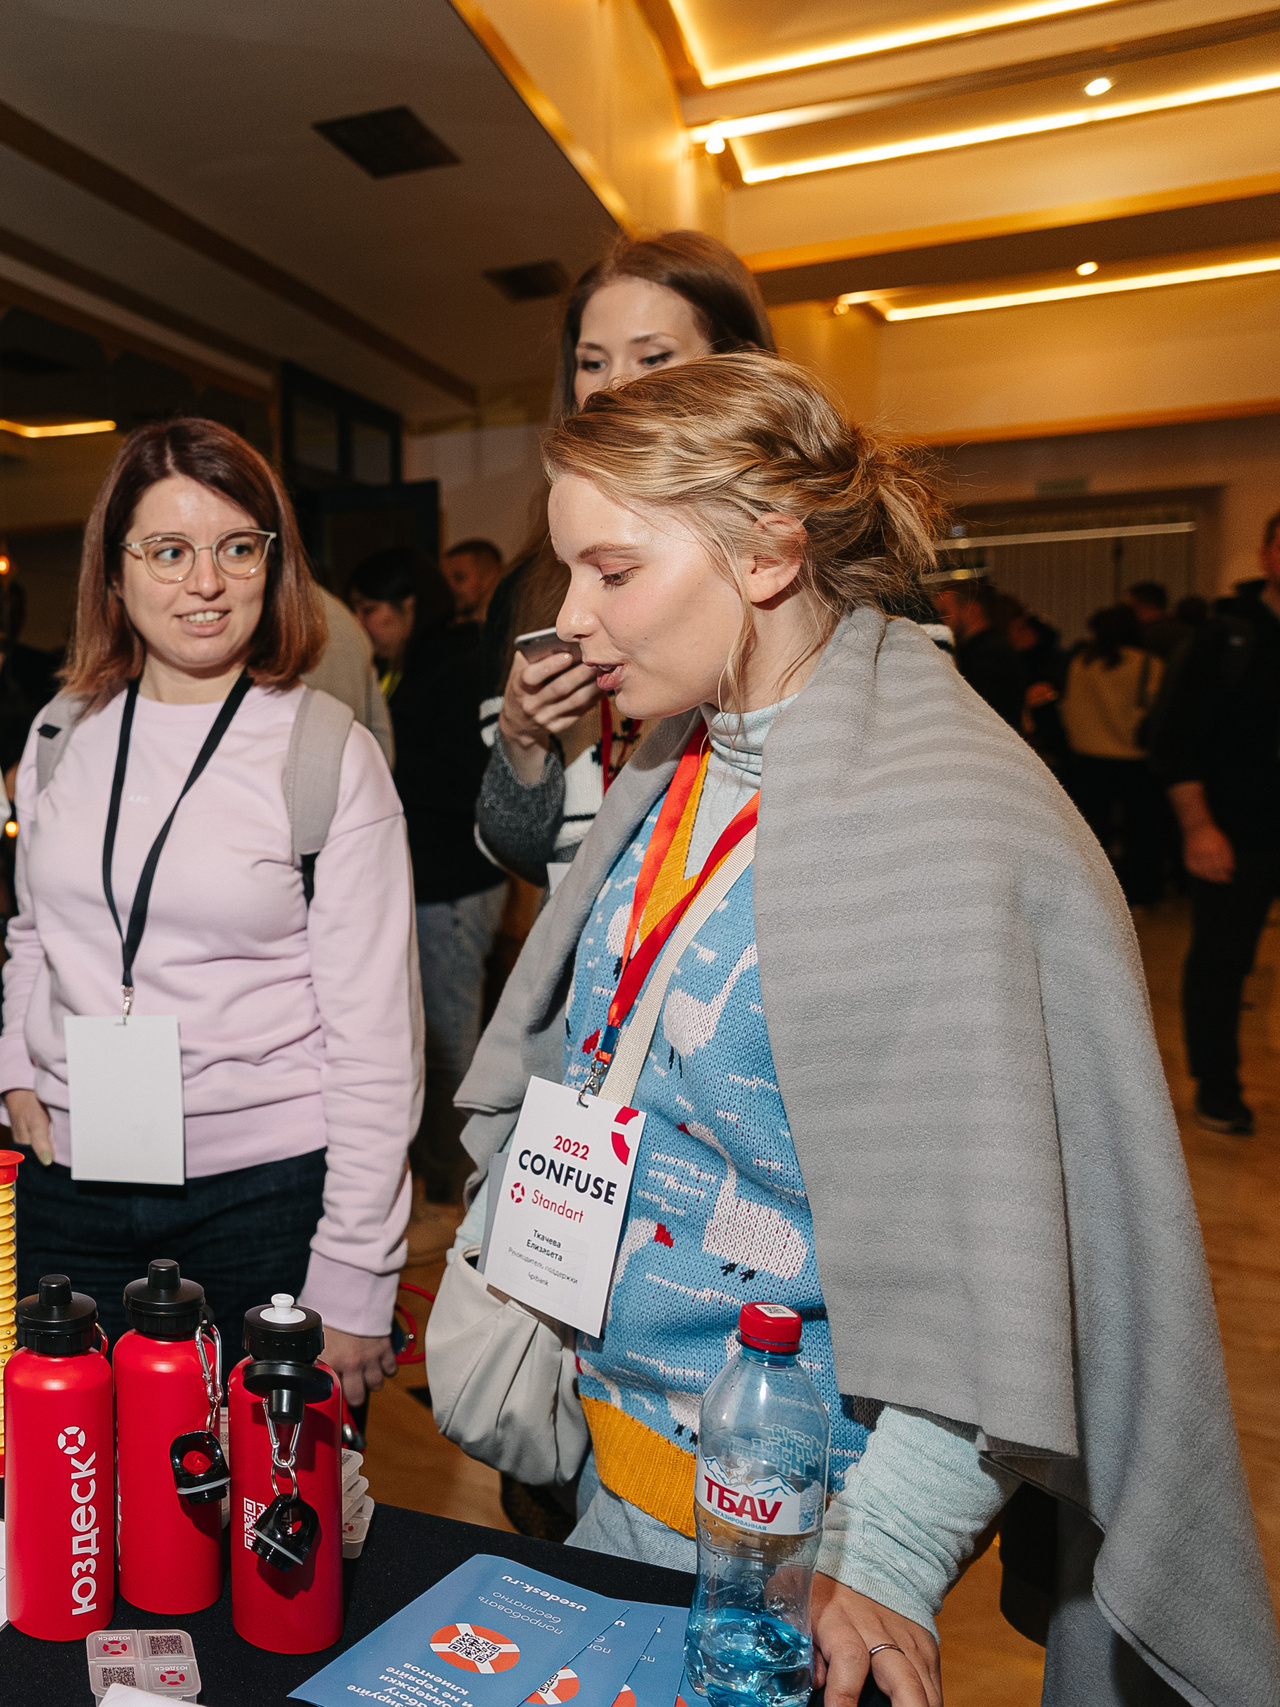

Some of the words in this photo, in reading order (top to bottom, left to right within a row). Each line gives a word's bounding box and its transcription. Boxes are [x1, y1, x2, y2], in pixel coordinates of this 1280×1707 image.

[553, 1135, 590, 1160] 2022
[518, 1149, 617, 1205] CONFUSE
[531, 1189, 584, 1223] Standart
[526, 1239, 563, 1261] Елизавета
[533, 1229, 561, 1249] Ткачева
[703, 1474, 783, 1525] ТБАУ
[711, 1506, 768, 1532] НЕГАЗИРОВАННАЯ
[492, 1591, 562, 1624] бесплатно
[501, 1575, 588, 1612] usedesk.ru
[478, 1595, 564, 1635] попробовать
[385, 1666, 439, 1693] теряйте
[403, 1662, 469, 1696] клиентов
[441, 1691, 461, 1703] не
